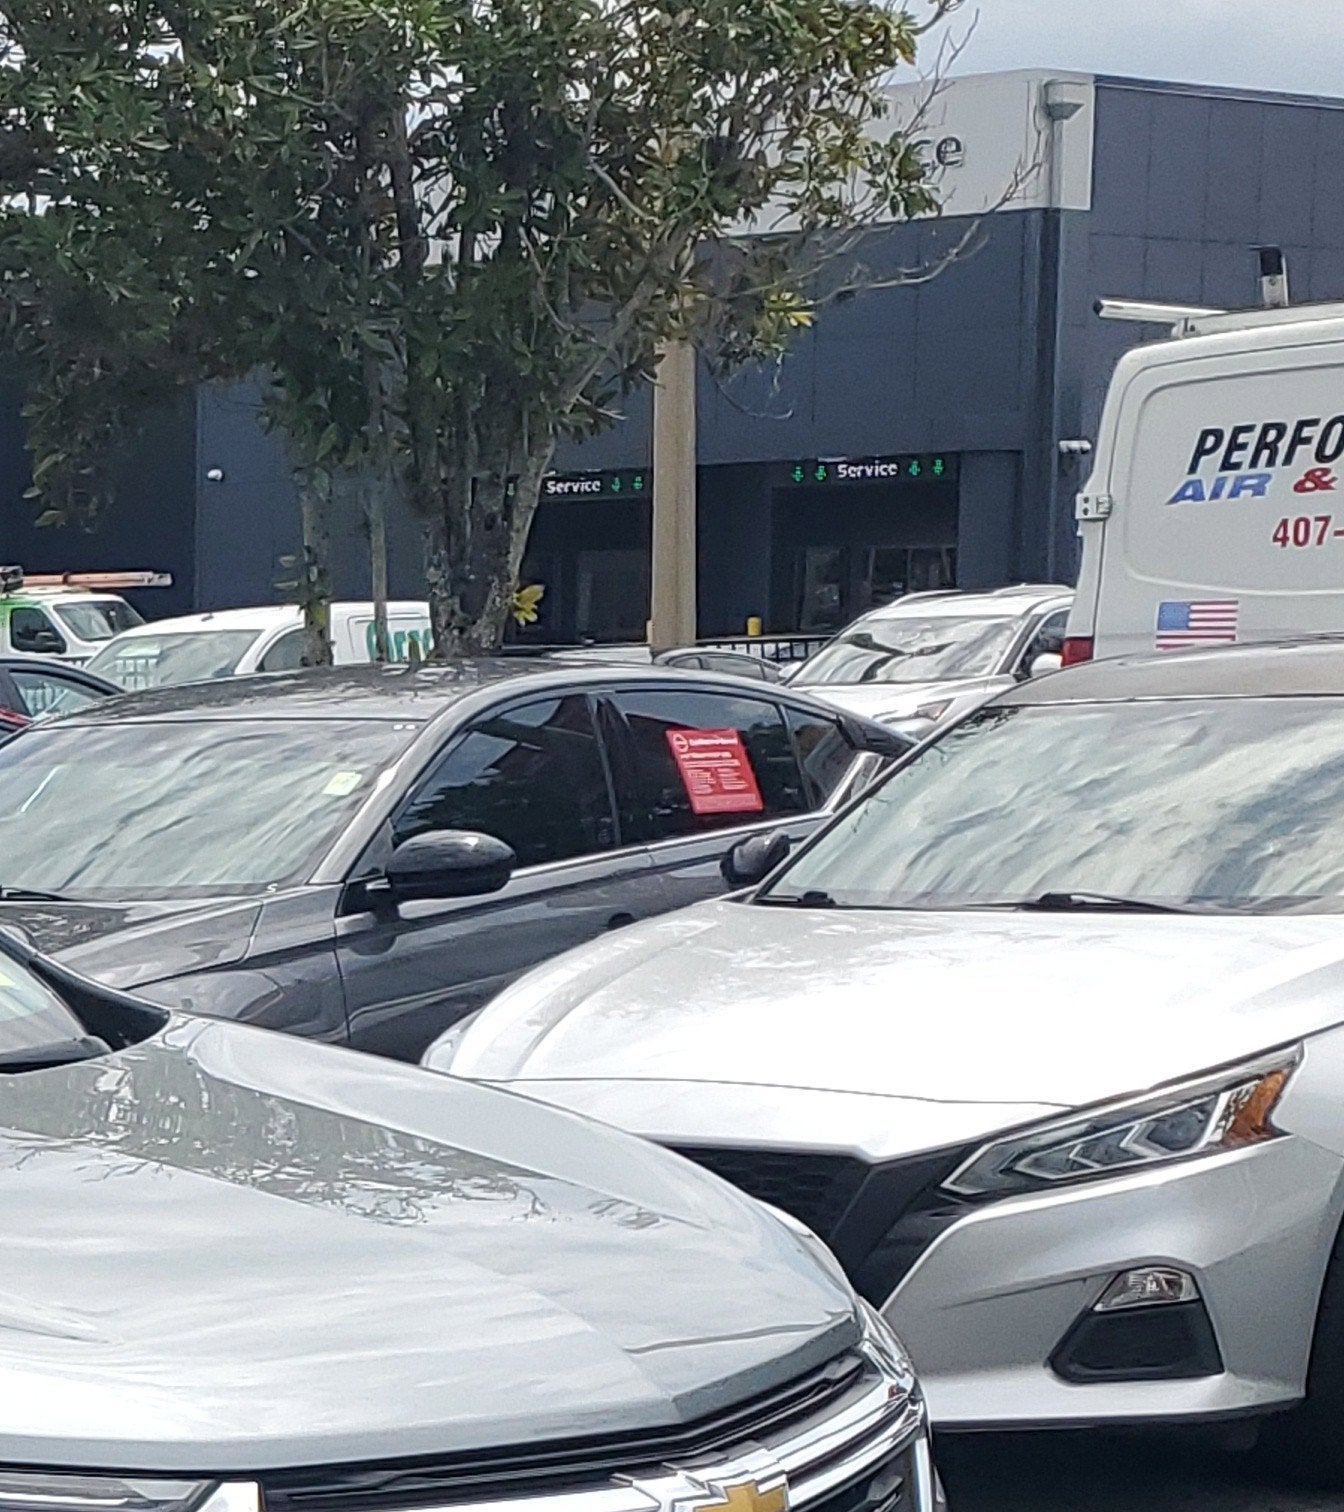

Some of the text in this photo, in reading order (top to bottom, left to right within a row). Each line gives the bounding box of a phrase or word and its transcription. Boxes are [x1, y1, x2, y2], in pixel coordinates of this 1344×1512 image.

[837, 460, 898, 478] Service
[546, 478, 601, 495] Service
[1165, 467, 1338, 505] AIR &
